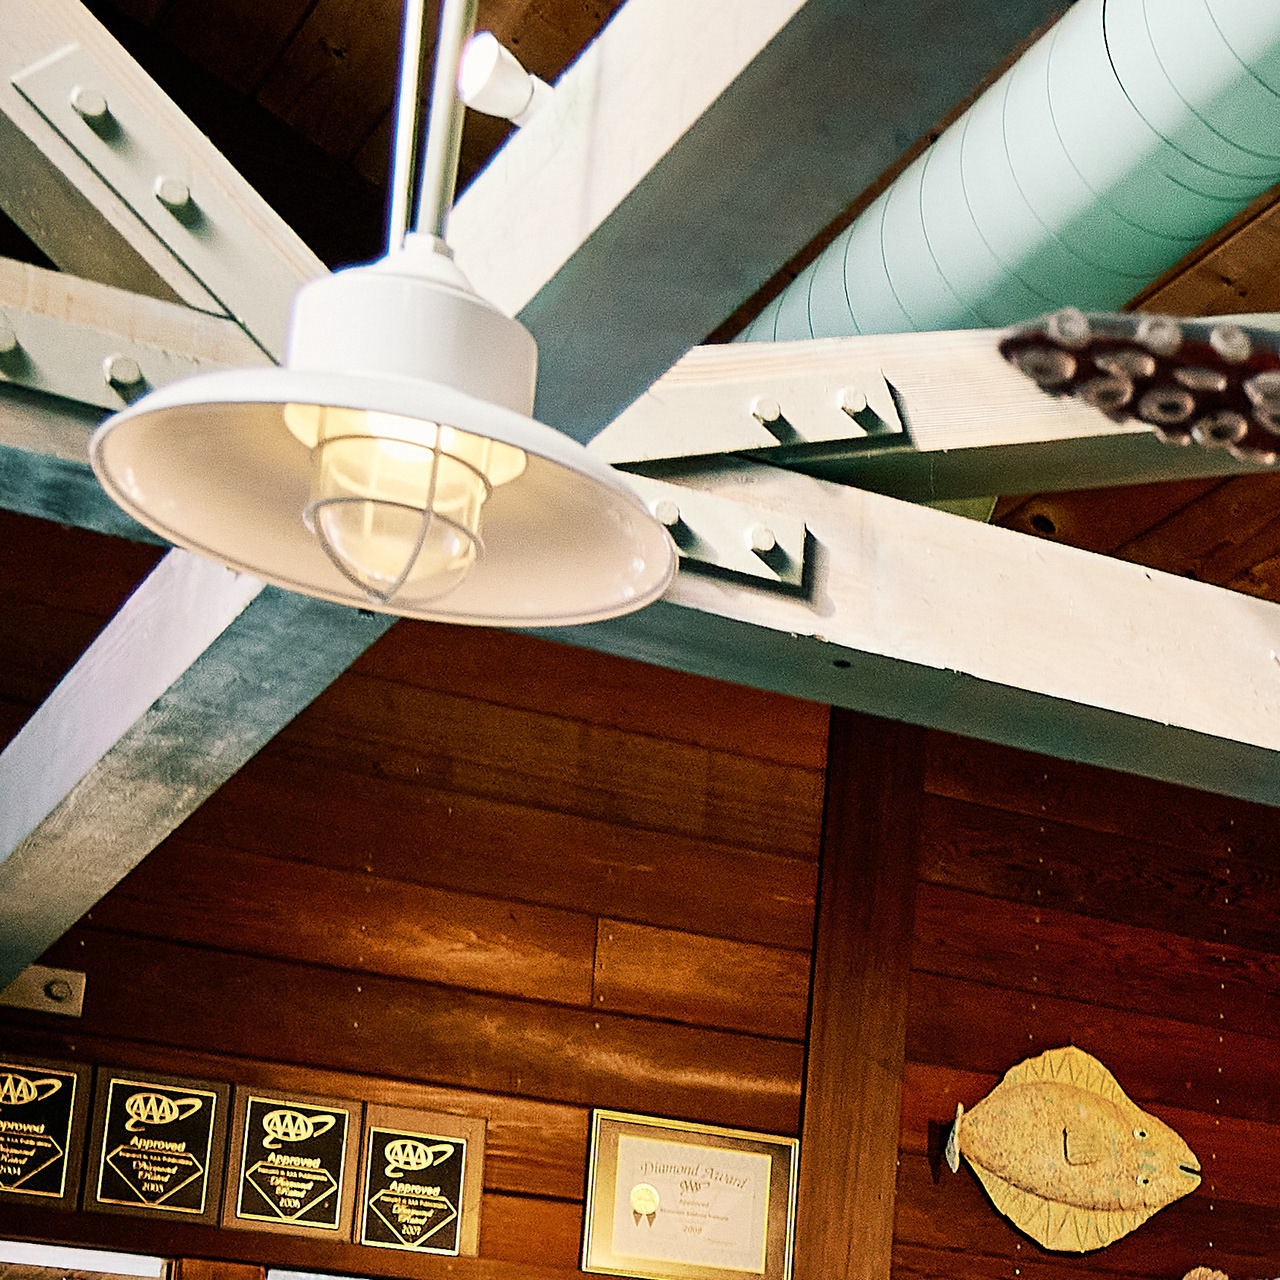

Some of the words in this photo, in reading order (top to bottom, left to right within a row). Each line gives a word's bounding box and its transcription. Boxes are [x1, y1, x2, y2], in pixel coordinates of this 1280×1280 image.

[0, 1120, 45, 1134] pproved
[130, 1135, 187, 1153] Approved
[267, 1152, 321, 1169] Approved
[640, 1161, 702, 1177] Diamond
[701, 1167, 750, 1189] Award
[389, 1180, 441, 1197] Approved
